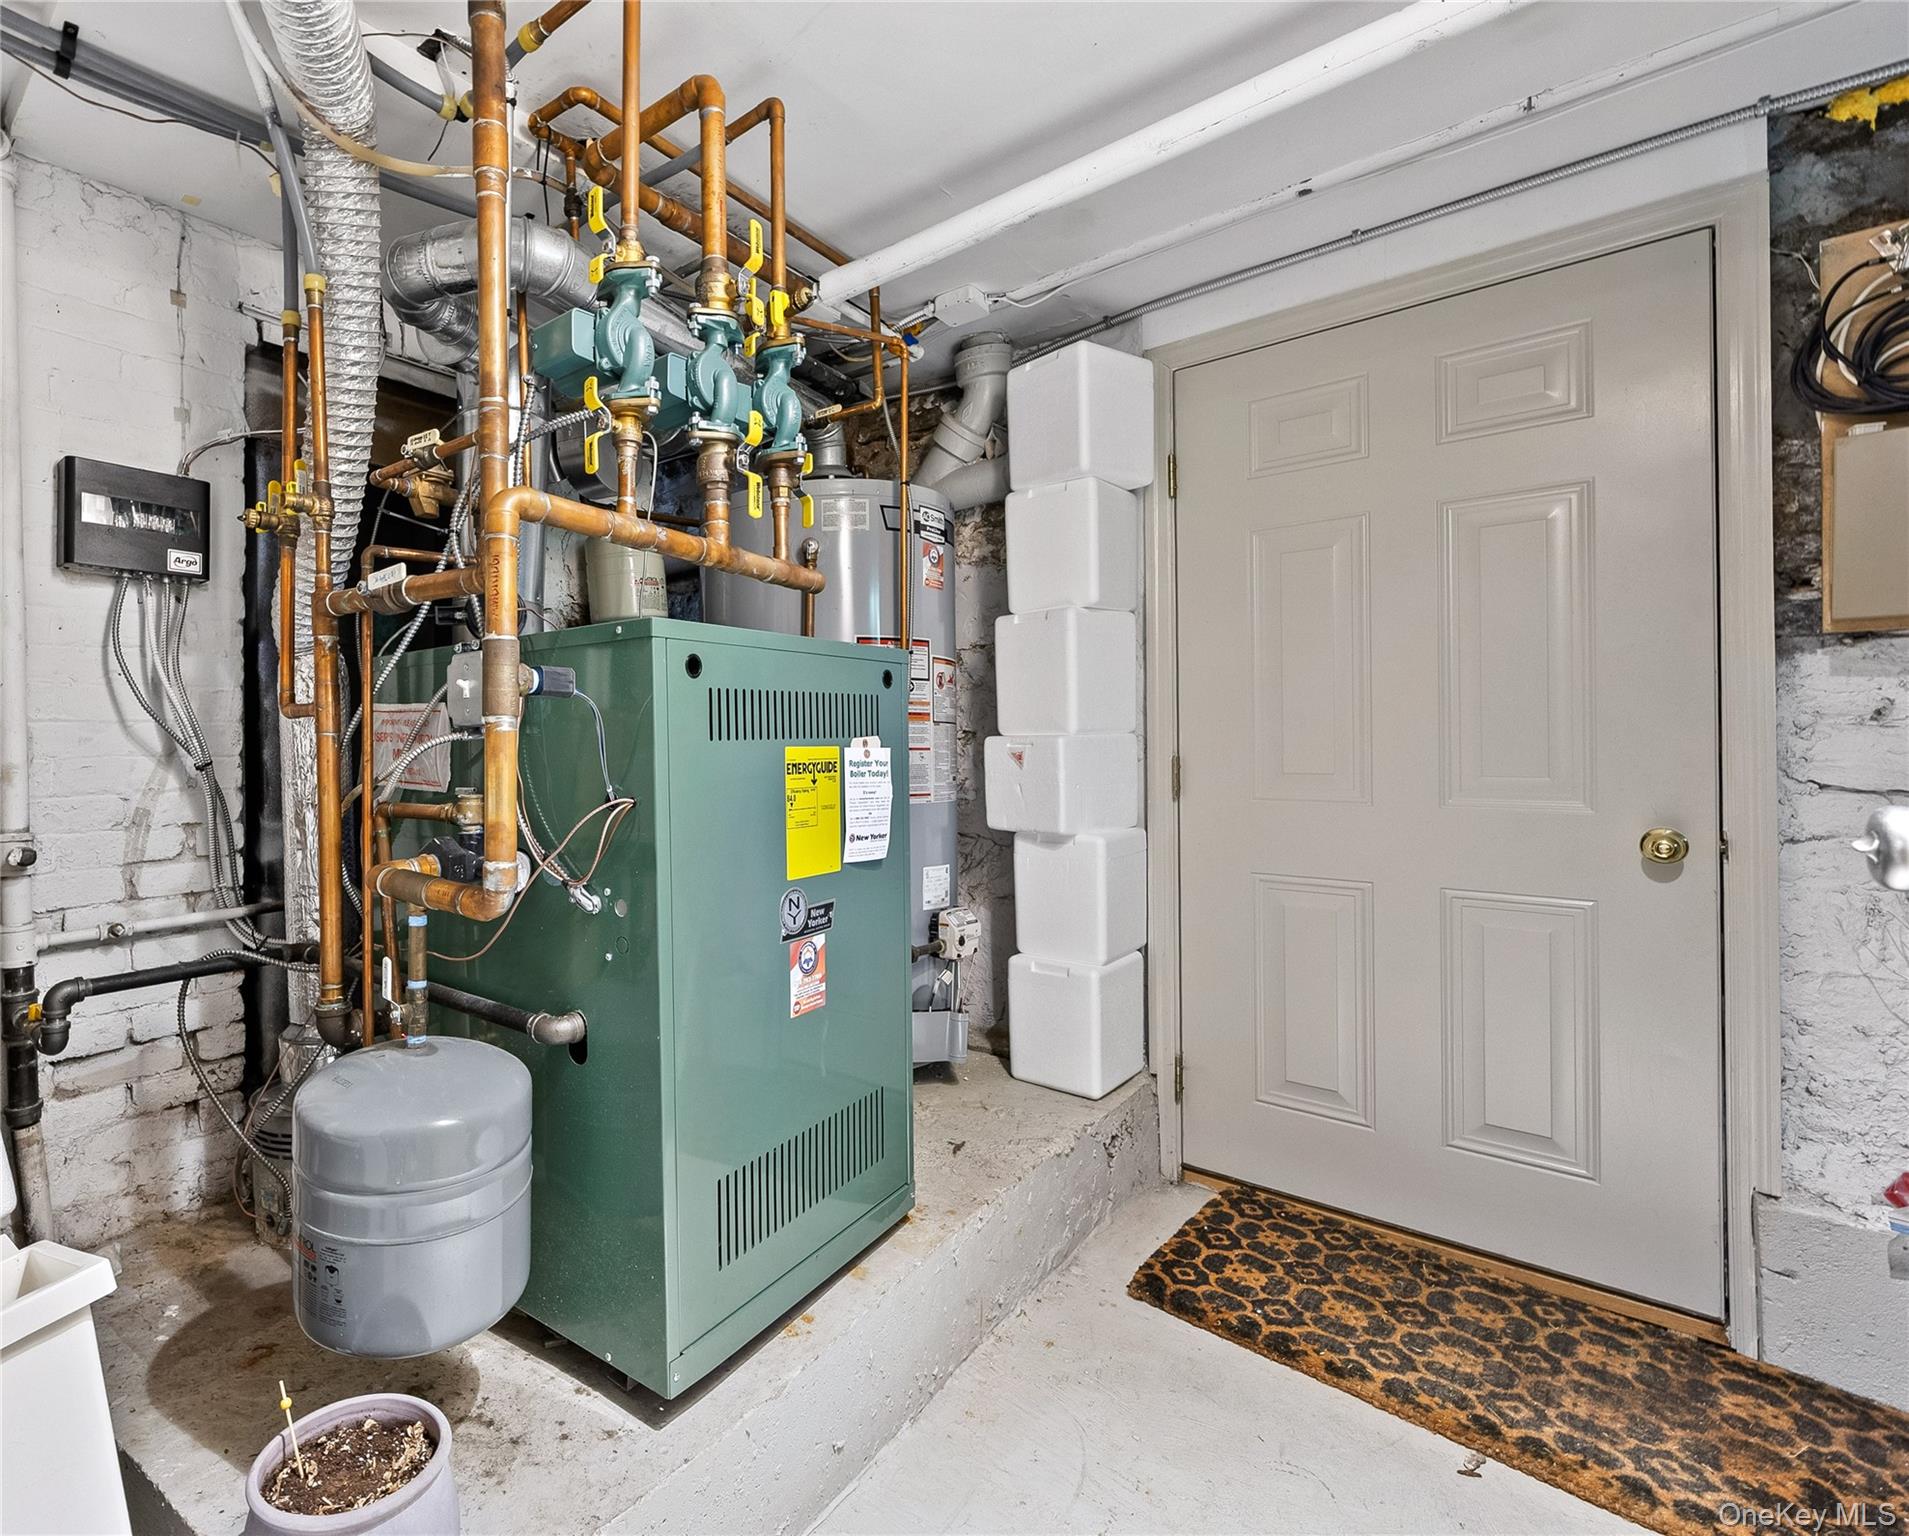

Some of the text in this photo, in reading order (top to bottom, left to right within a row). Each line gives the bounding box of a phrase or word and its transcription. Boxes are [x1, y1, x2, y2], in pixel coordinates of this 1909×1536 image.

[930, 513, 944, 524] Smith
[173, 556, 198, 567] Argo
[786, 761, 838, 775] ENERGYGUIDE
[849, 759, 888, 768] Register Your
[850, 770, 888, 779] Boiler Today!
[810, 908, 825, 918] New
[807, 916, 828, 928] Yorker
